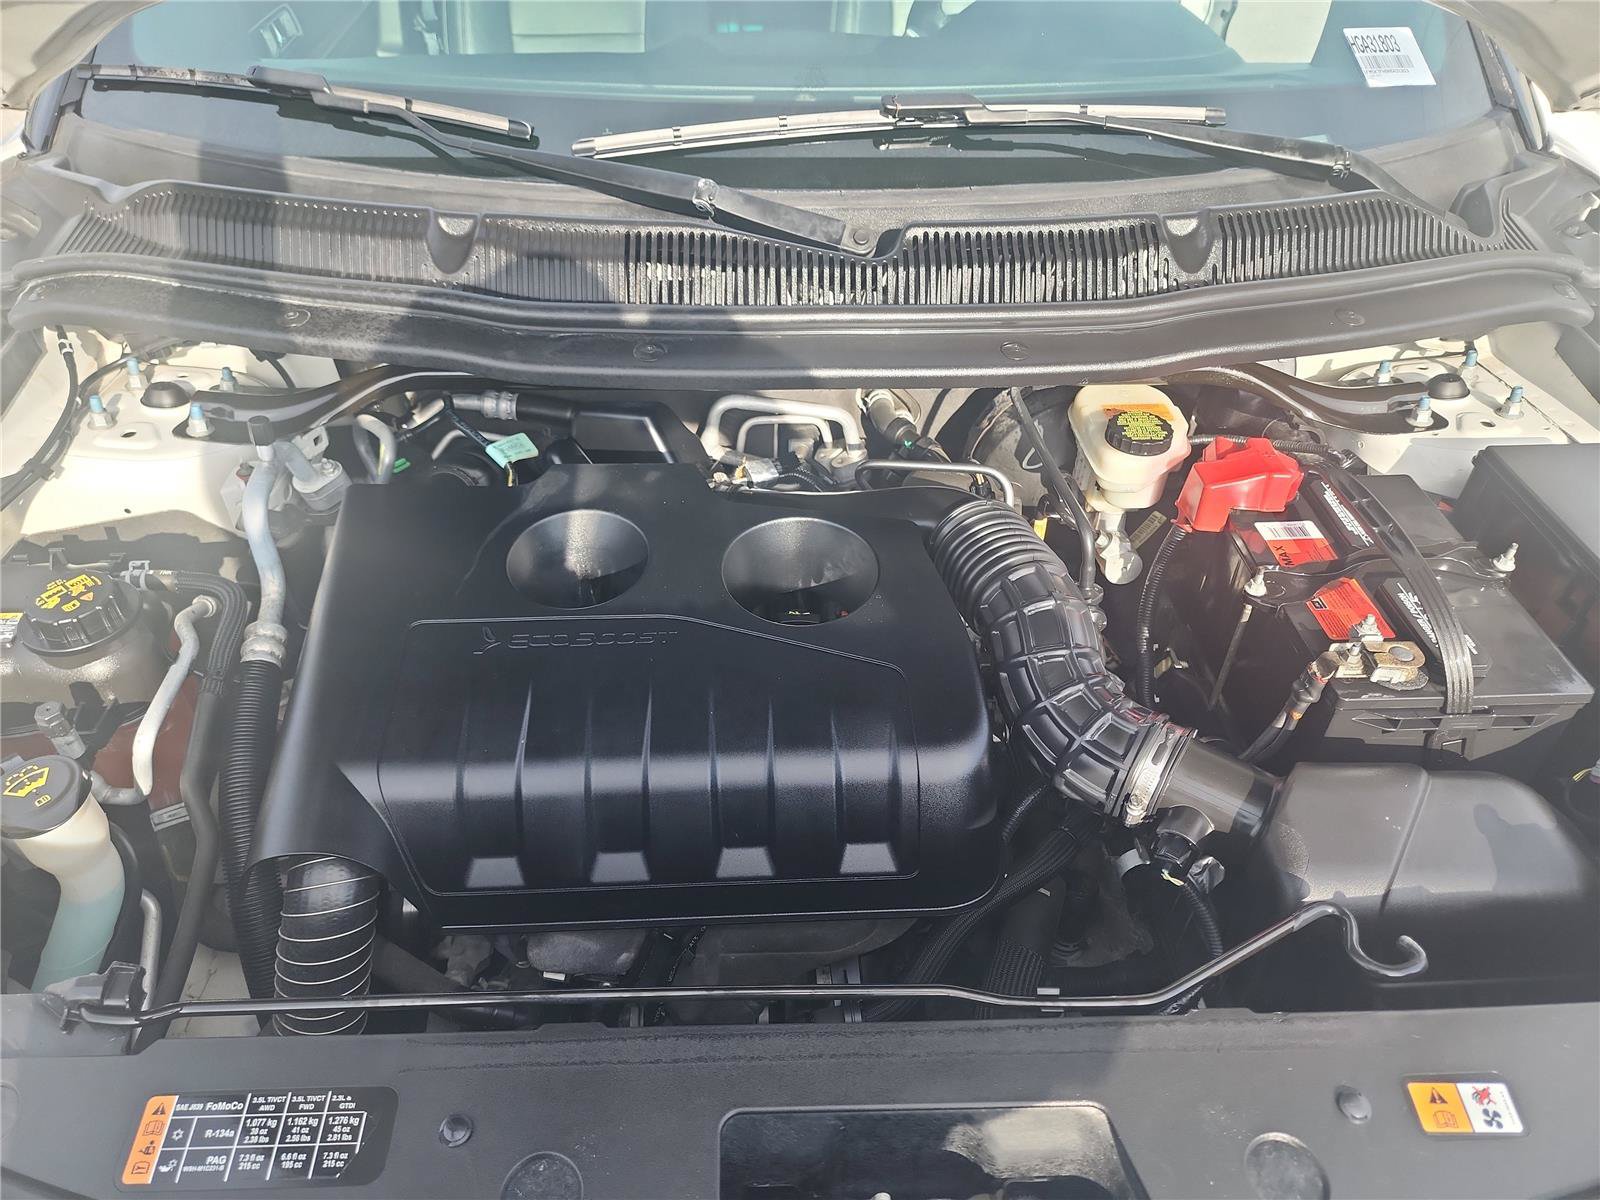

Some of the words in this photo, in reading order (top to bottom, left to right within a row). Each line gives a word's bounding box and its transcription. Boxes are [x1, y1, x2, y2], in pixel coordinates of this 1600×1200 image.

[205, 1101, 244, 1112] FoMoCo
[246, 1118, 267, 1127] 1.077
[267, 1118, 278, 1128] kg
[287, 1117, 308, 1126] 1.162
[308, 1116, 319, 1127] kg
[328, 1116, 349, 1125] 1.276
[349, 1116, 360, 1126] kg
[205, 1128, 235, 1138] R-134a
[326, 1134, 341, 1142] 2.81
[206, 1155, 227, 1165] PAG
[280, 1153, 291, 1161] 6.6
[323, 1152, 333, 1160] 7.3
[238, 1162, 251, 1170] 215
[281, 1161, 294, 1169] 195
[322, 1160, 335, 1168] 215
